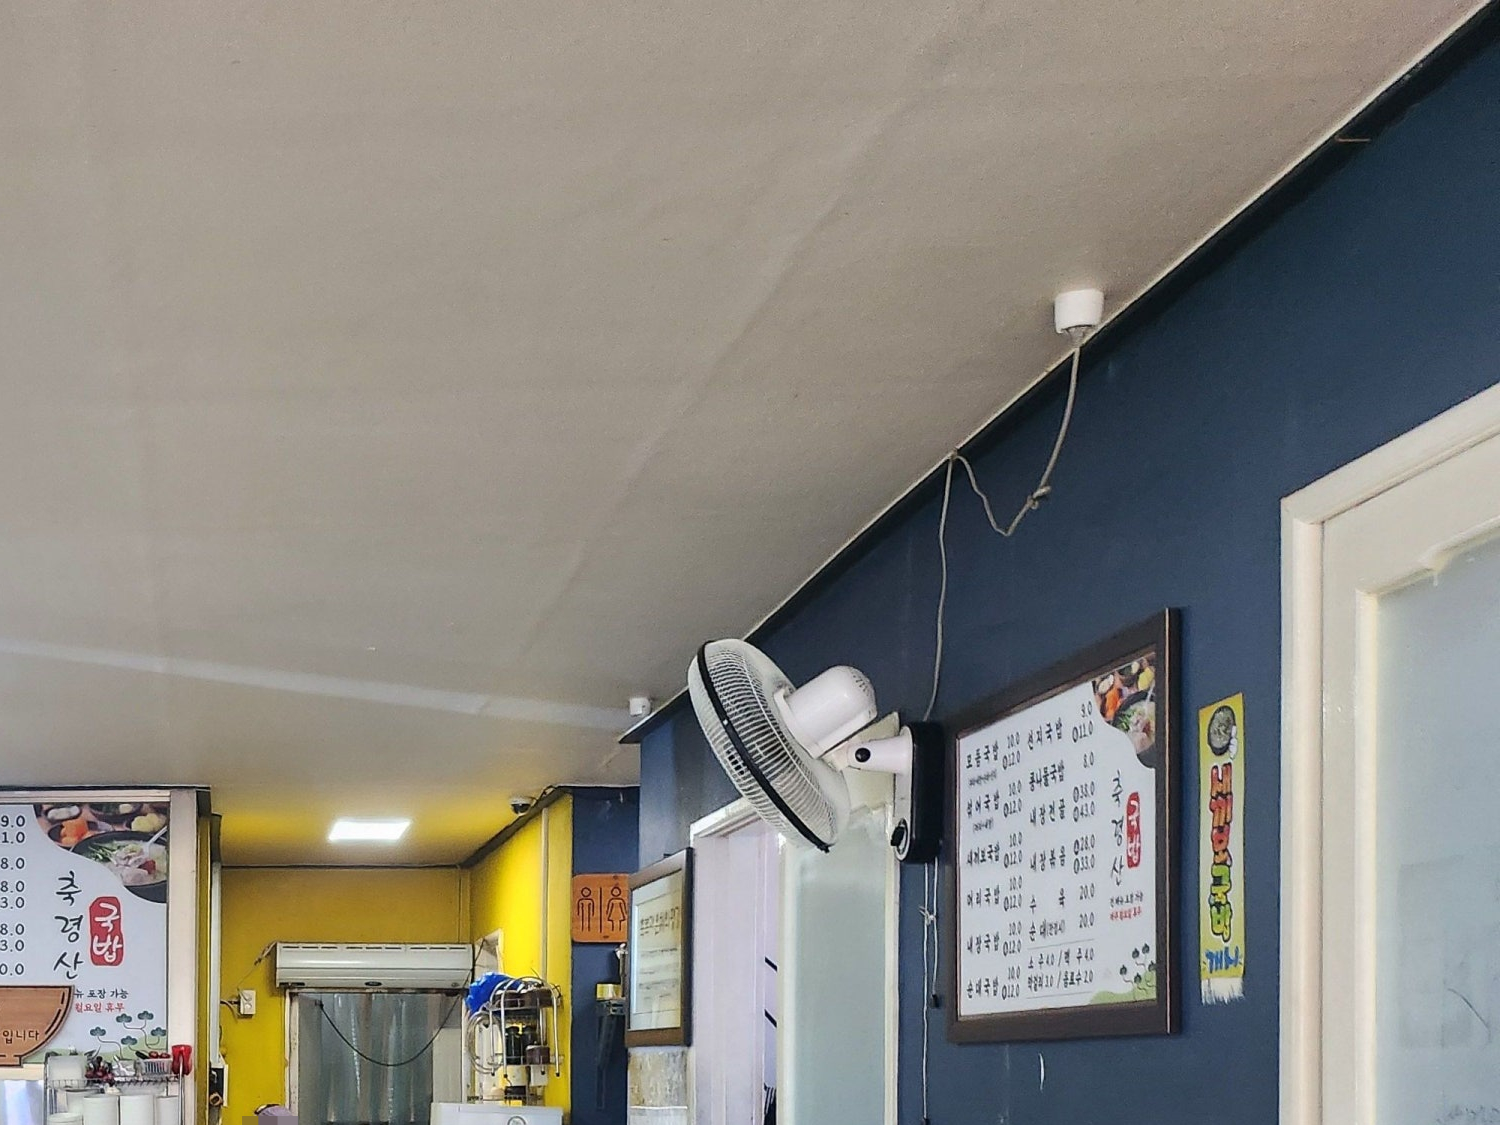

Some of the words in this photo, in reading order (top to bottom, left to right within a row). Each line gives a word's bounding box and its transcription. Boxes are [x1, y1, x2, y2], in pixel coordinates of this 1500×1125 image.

[0, 815, 26, 828] 9.0
[0, 857, 26, 870] 8.0
[92, 902, 123, 963] 국밥
